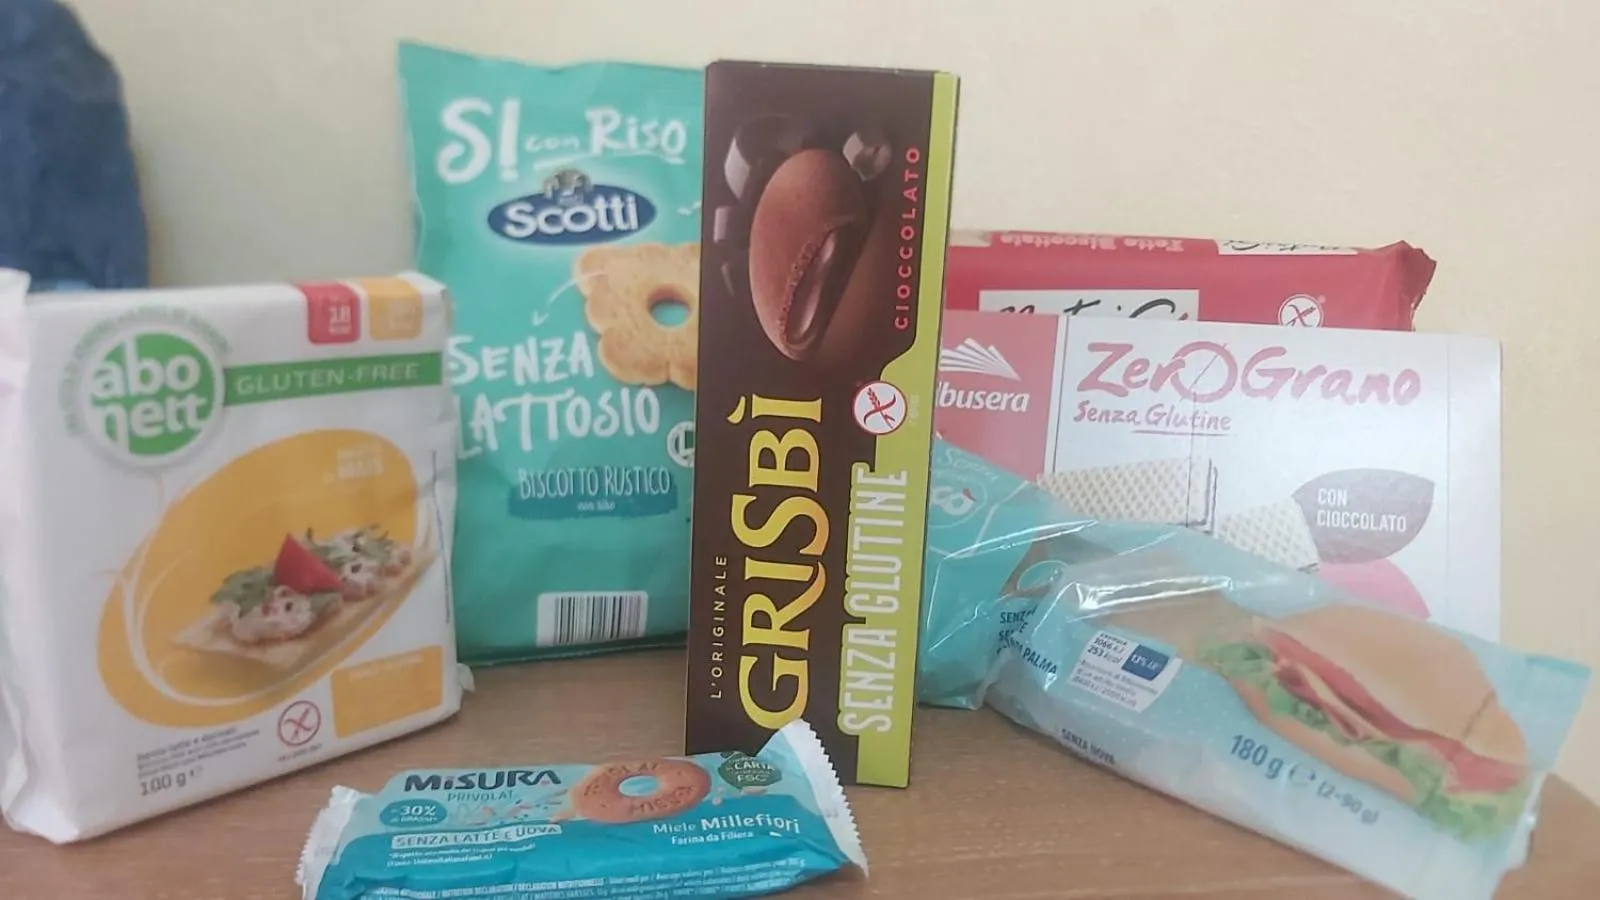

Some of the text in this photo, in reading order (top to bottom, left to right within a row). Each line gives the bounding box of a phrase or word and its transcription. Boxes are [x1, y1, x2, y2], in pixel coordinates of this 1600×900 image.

[524, 134, 581, 153] con
[585, 105, 687, 156] Riso
[503, 195, 639, 238] Scotti
[895, 147, 920, 330] CIOCCOLATO
[92, 336, 201, 398] abo
[234, 362, 421, 396] GLUTEN-FREE
[447, 331, 594, 385] SENZA
[453, 388, 660, 460] LATTOSIO
[1073, 401, 1233, 431] Senza Glutine
[519, 465, 671, 499] BISCOTTO RUSTICO
[1317, 488, 1348, 507] CON
[1316, 509, 1407, 533] CIOCCOLATO
[843, 467, 908, 734] SENZA GLUTINE
[709, 556, 727, 699] L'ORIGINALE
[1229, 734, 1269, 767] 180
[1265, 757, 1285, 780] g
[395, 834, 450, 847] SENZA
[452, 831, 499, 844] LATTE
[515, 825, 558, 838] UOVA
[653, 813, 800, 834] Miele Millefiori
[671, 834, 704, 846] Farina
[706, 833, 720, 843] da
